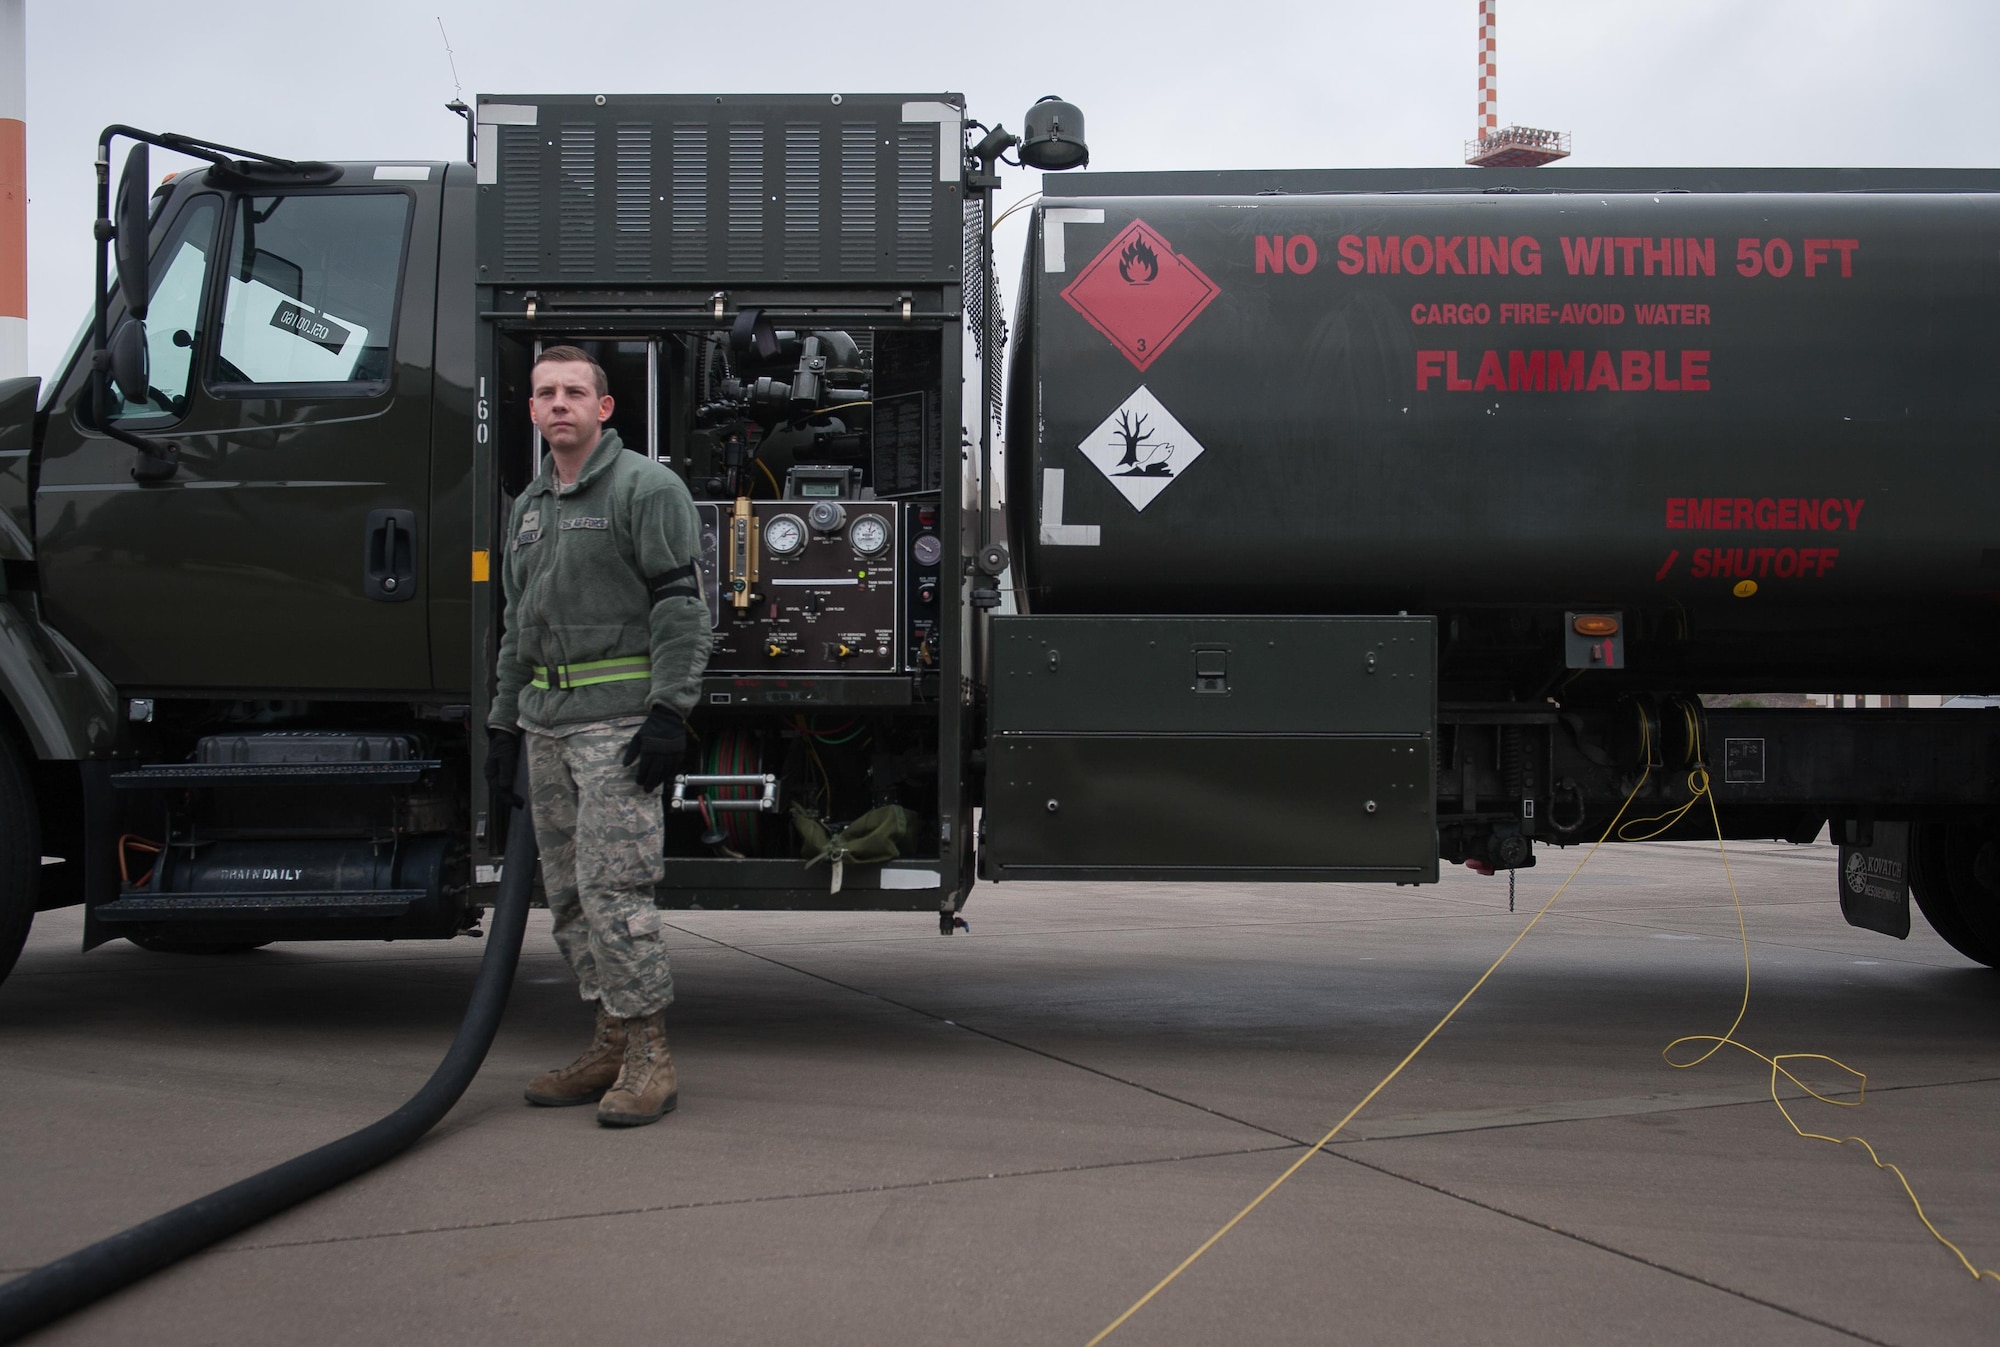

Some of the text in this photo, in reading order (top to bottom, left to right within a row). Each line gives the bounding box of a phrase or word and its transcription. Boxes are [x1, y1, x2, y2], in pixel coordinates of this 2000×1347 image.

[1255, 234, 1858, 278] NO SMOKING WITHIN 50 FT
[1411, 303, 1711, 325] CARGO FIRE-AVOID WATER
[1137, 338, 1146, 352] 3
[1416, 350, 1710, 392] FLAMMABLE
[476, 376, 489, 444] 160
[1666, 498, 1864, 531] EMERGENCY
[1691, 548, 1839, 579] SHUTOFF
[221, 869, 302, 880] DRAIN DAILY
[1867, 856, 1902, 878] KOVATCH
